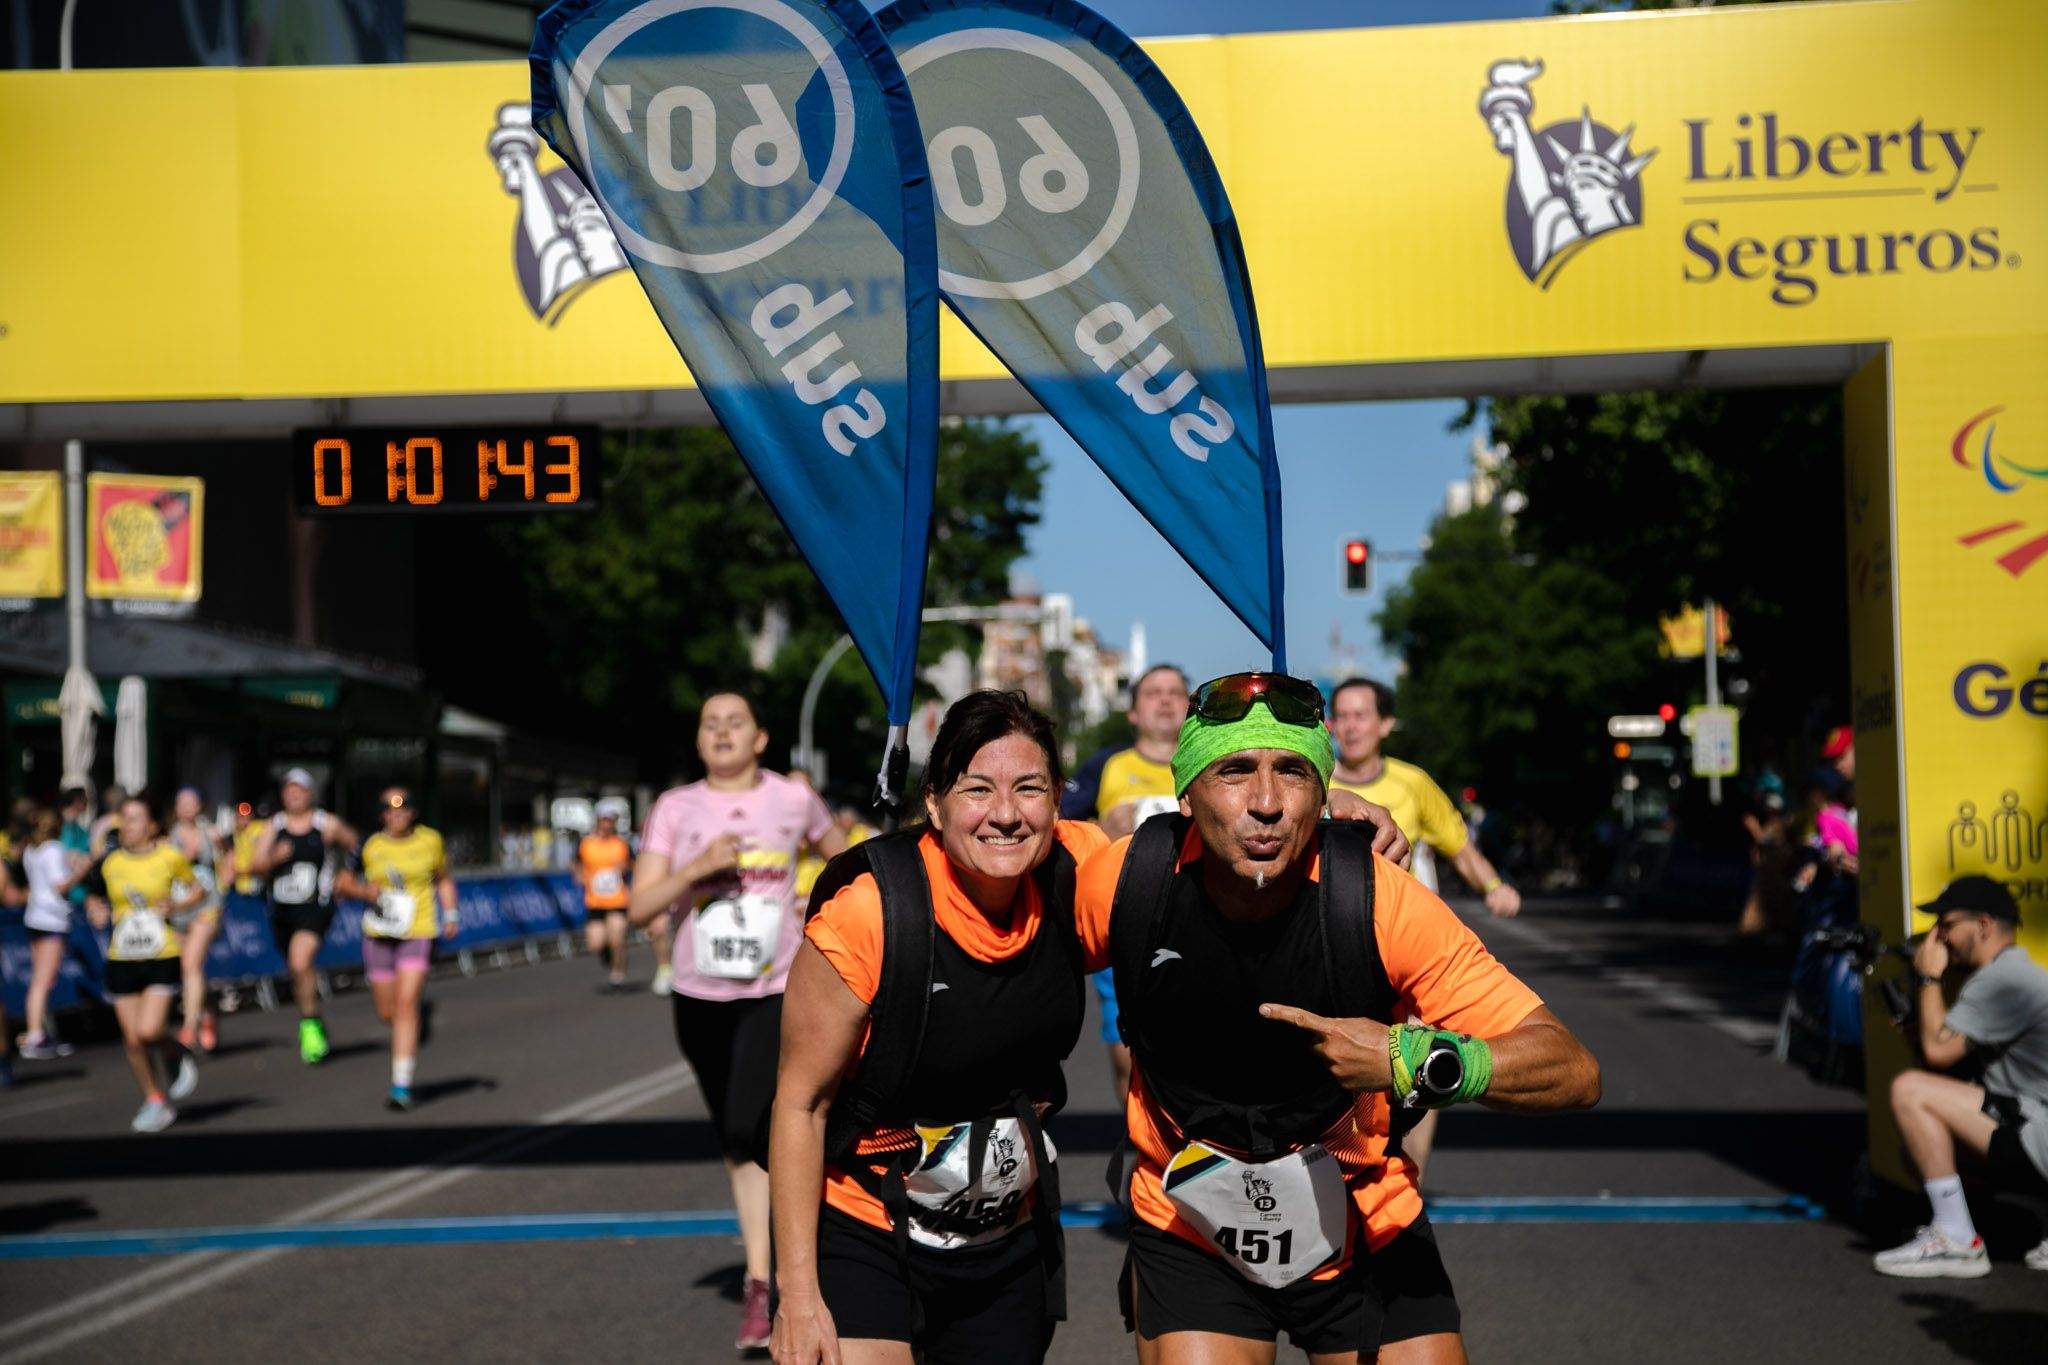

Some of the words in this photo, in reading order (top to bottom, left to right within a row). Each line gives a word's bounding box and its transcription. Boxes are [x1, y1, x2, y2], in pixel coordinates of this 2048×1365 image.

[1681, 111, 1984, 202] Liberty
[1682, 218, 2001, 306] Seguros
[1258, 1199, 1273, 1209] 13
[1214, 1226, 1293, 1265] 451
